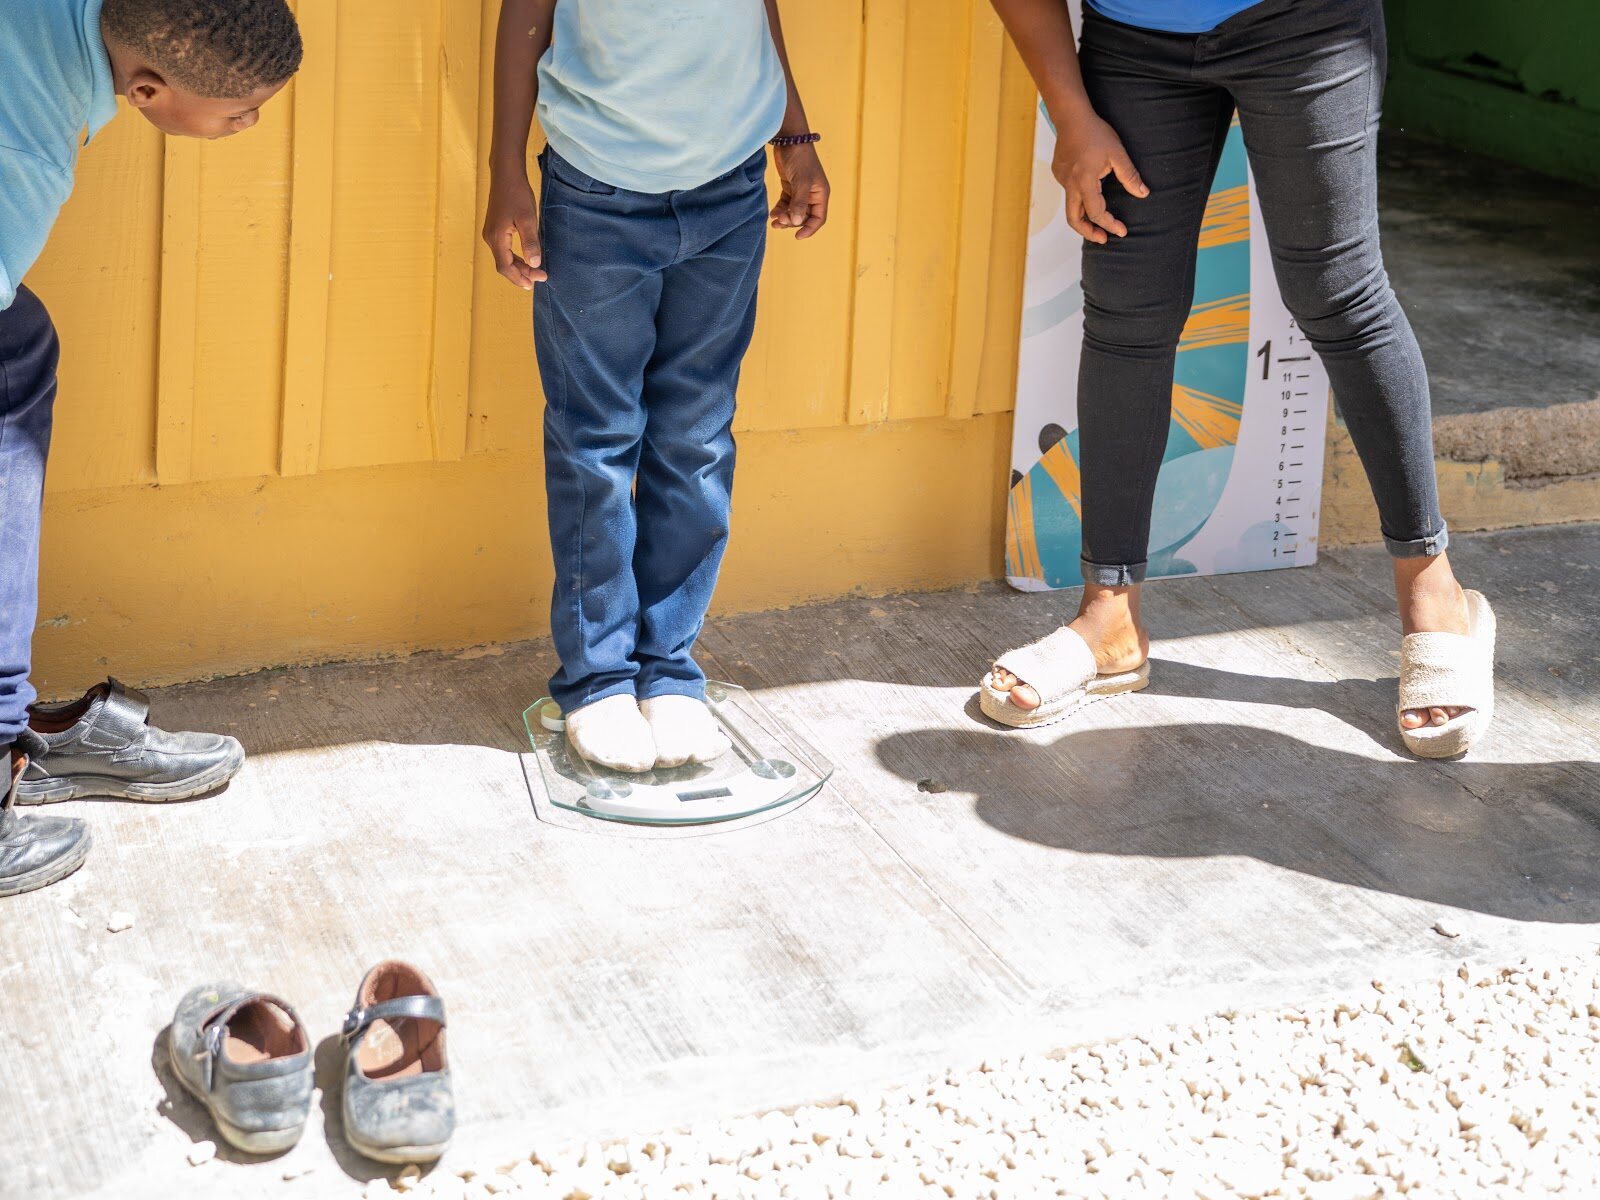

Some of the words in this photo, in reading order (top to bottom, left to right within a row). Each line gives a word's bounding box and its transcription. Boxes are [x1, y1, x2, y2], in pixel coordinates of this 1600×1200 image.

[1289, 318, 1296, 329] 2
[1288, 335, 1293, 345] 1
[1256, 339, 1272, 381] 1
[1282, 372, 1292, 382] 11
[1280, 390, 1291, 401] 10
[1282, 407, 1289, 418] 9
[1281, 425, 1287, 436] 8
[1280, 443, 1286, 454] 7
[1278, 461, 1285, 472] 6
[1277, 478, 1283, 489] 5
[1275, 496, 1282, 506] 4
[1274, 512, 1281, 523] 3
[1272, 530, 1279, 541] 2
[1272, 547, 1277, 558] 1
